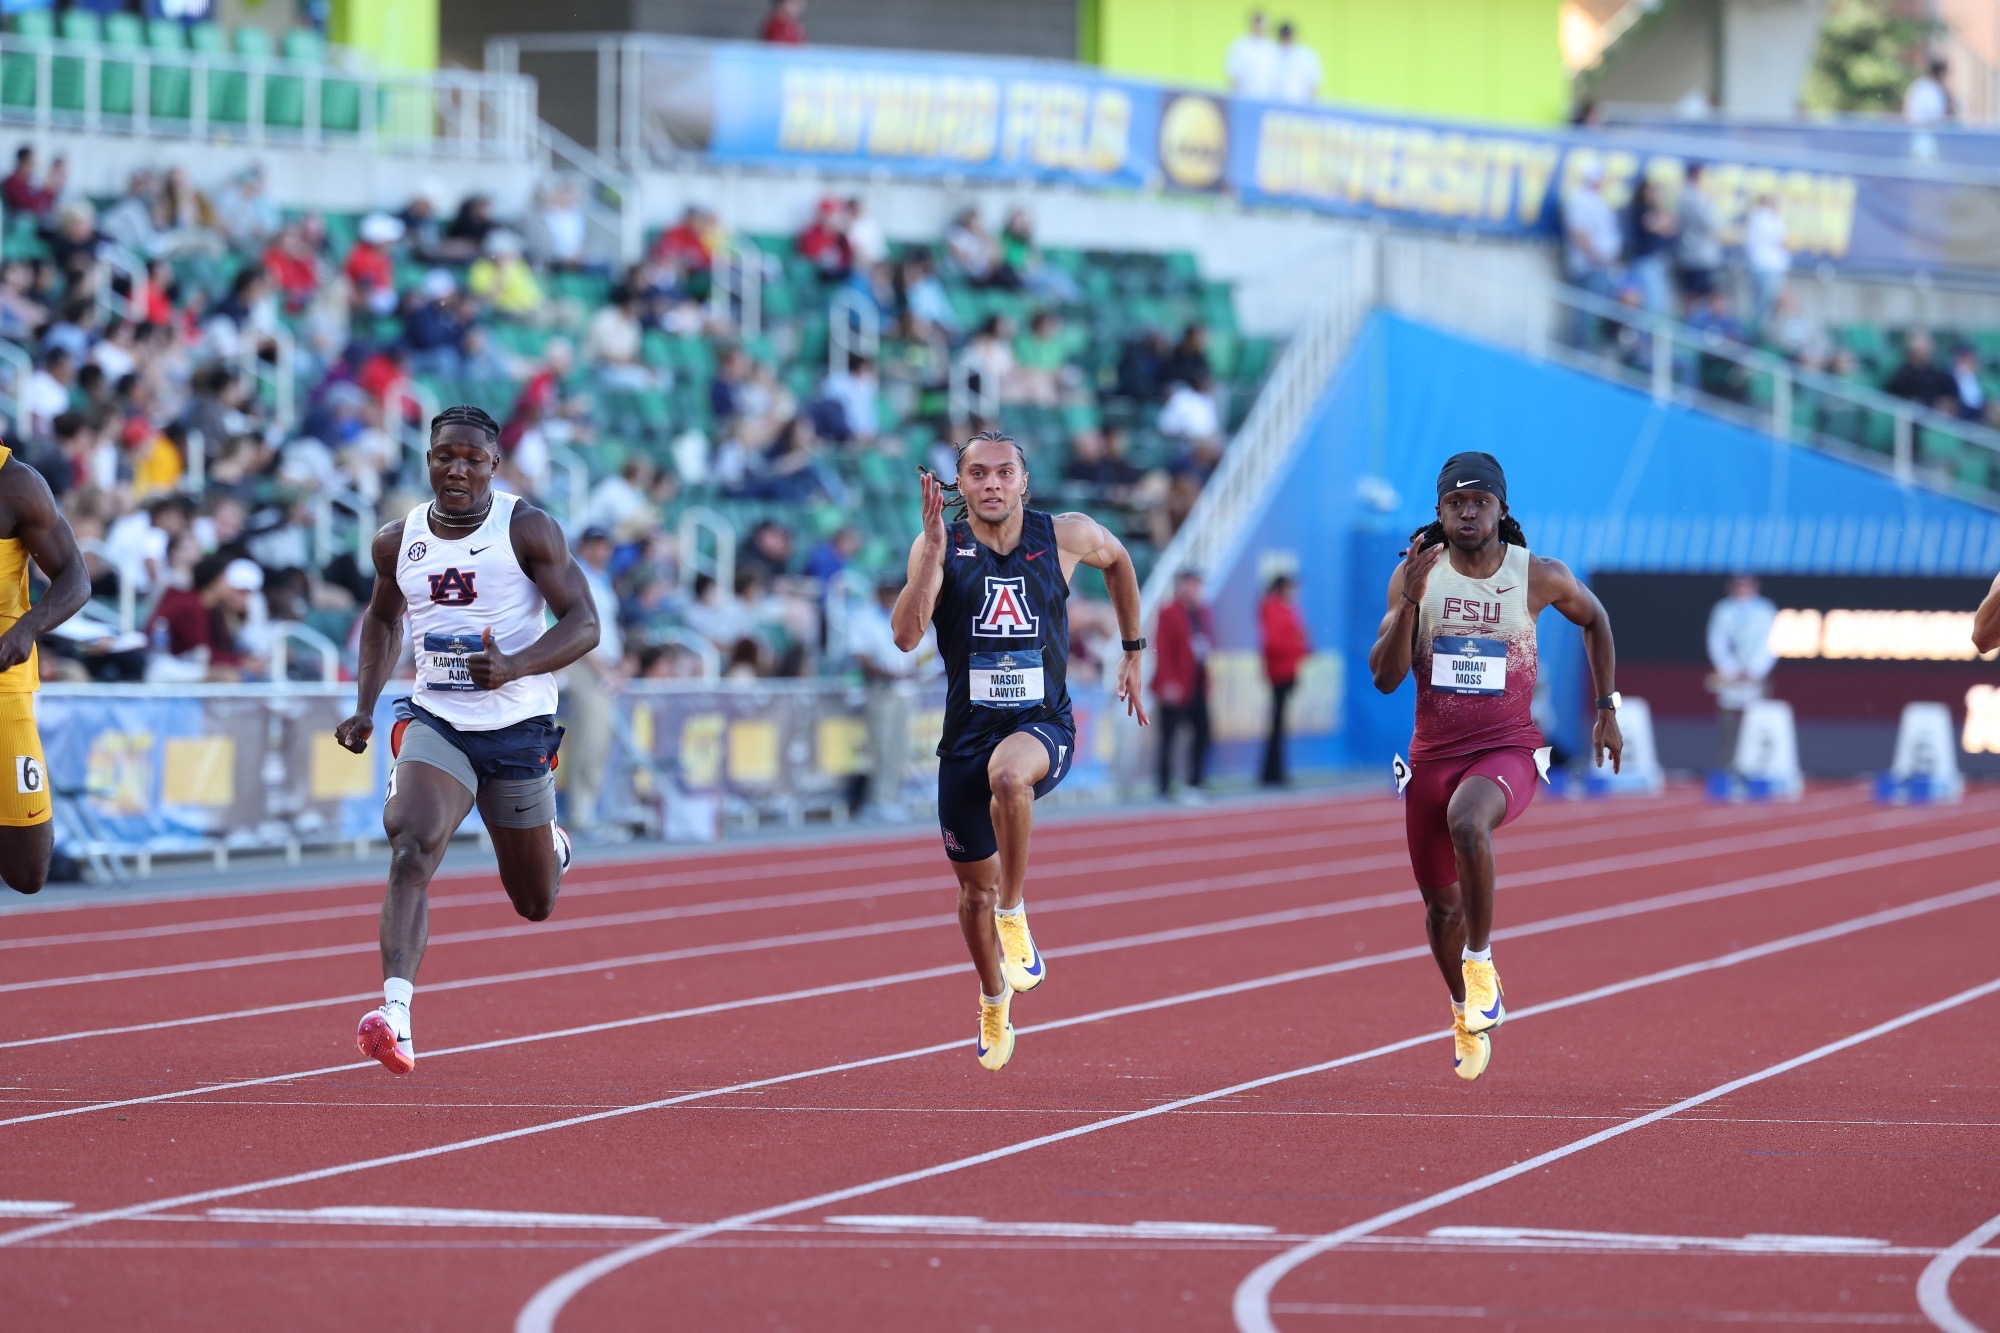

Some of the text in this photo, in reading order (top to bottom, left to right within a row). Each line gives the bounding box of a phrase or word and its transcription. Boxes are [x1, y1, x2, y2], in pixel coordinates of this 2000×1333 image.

[972, 576, 1040, 637] A
[1442, 598, 1501, 623] FSU
[433, 656, 469, 668] KANYINS
[1452, 660, 1487, 672] DURIAN
[991, 674, 1024, 685] MASON
[1455, 673, 1482, 685] MOSS
[989, 687, 1026, 698] LAWYER
[23, 756, 39, 791] 6
